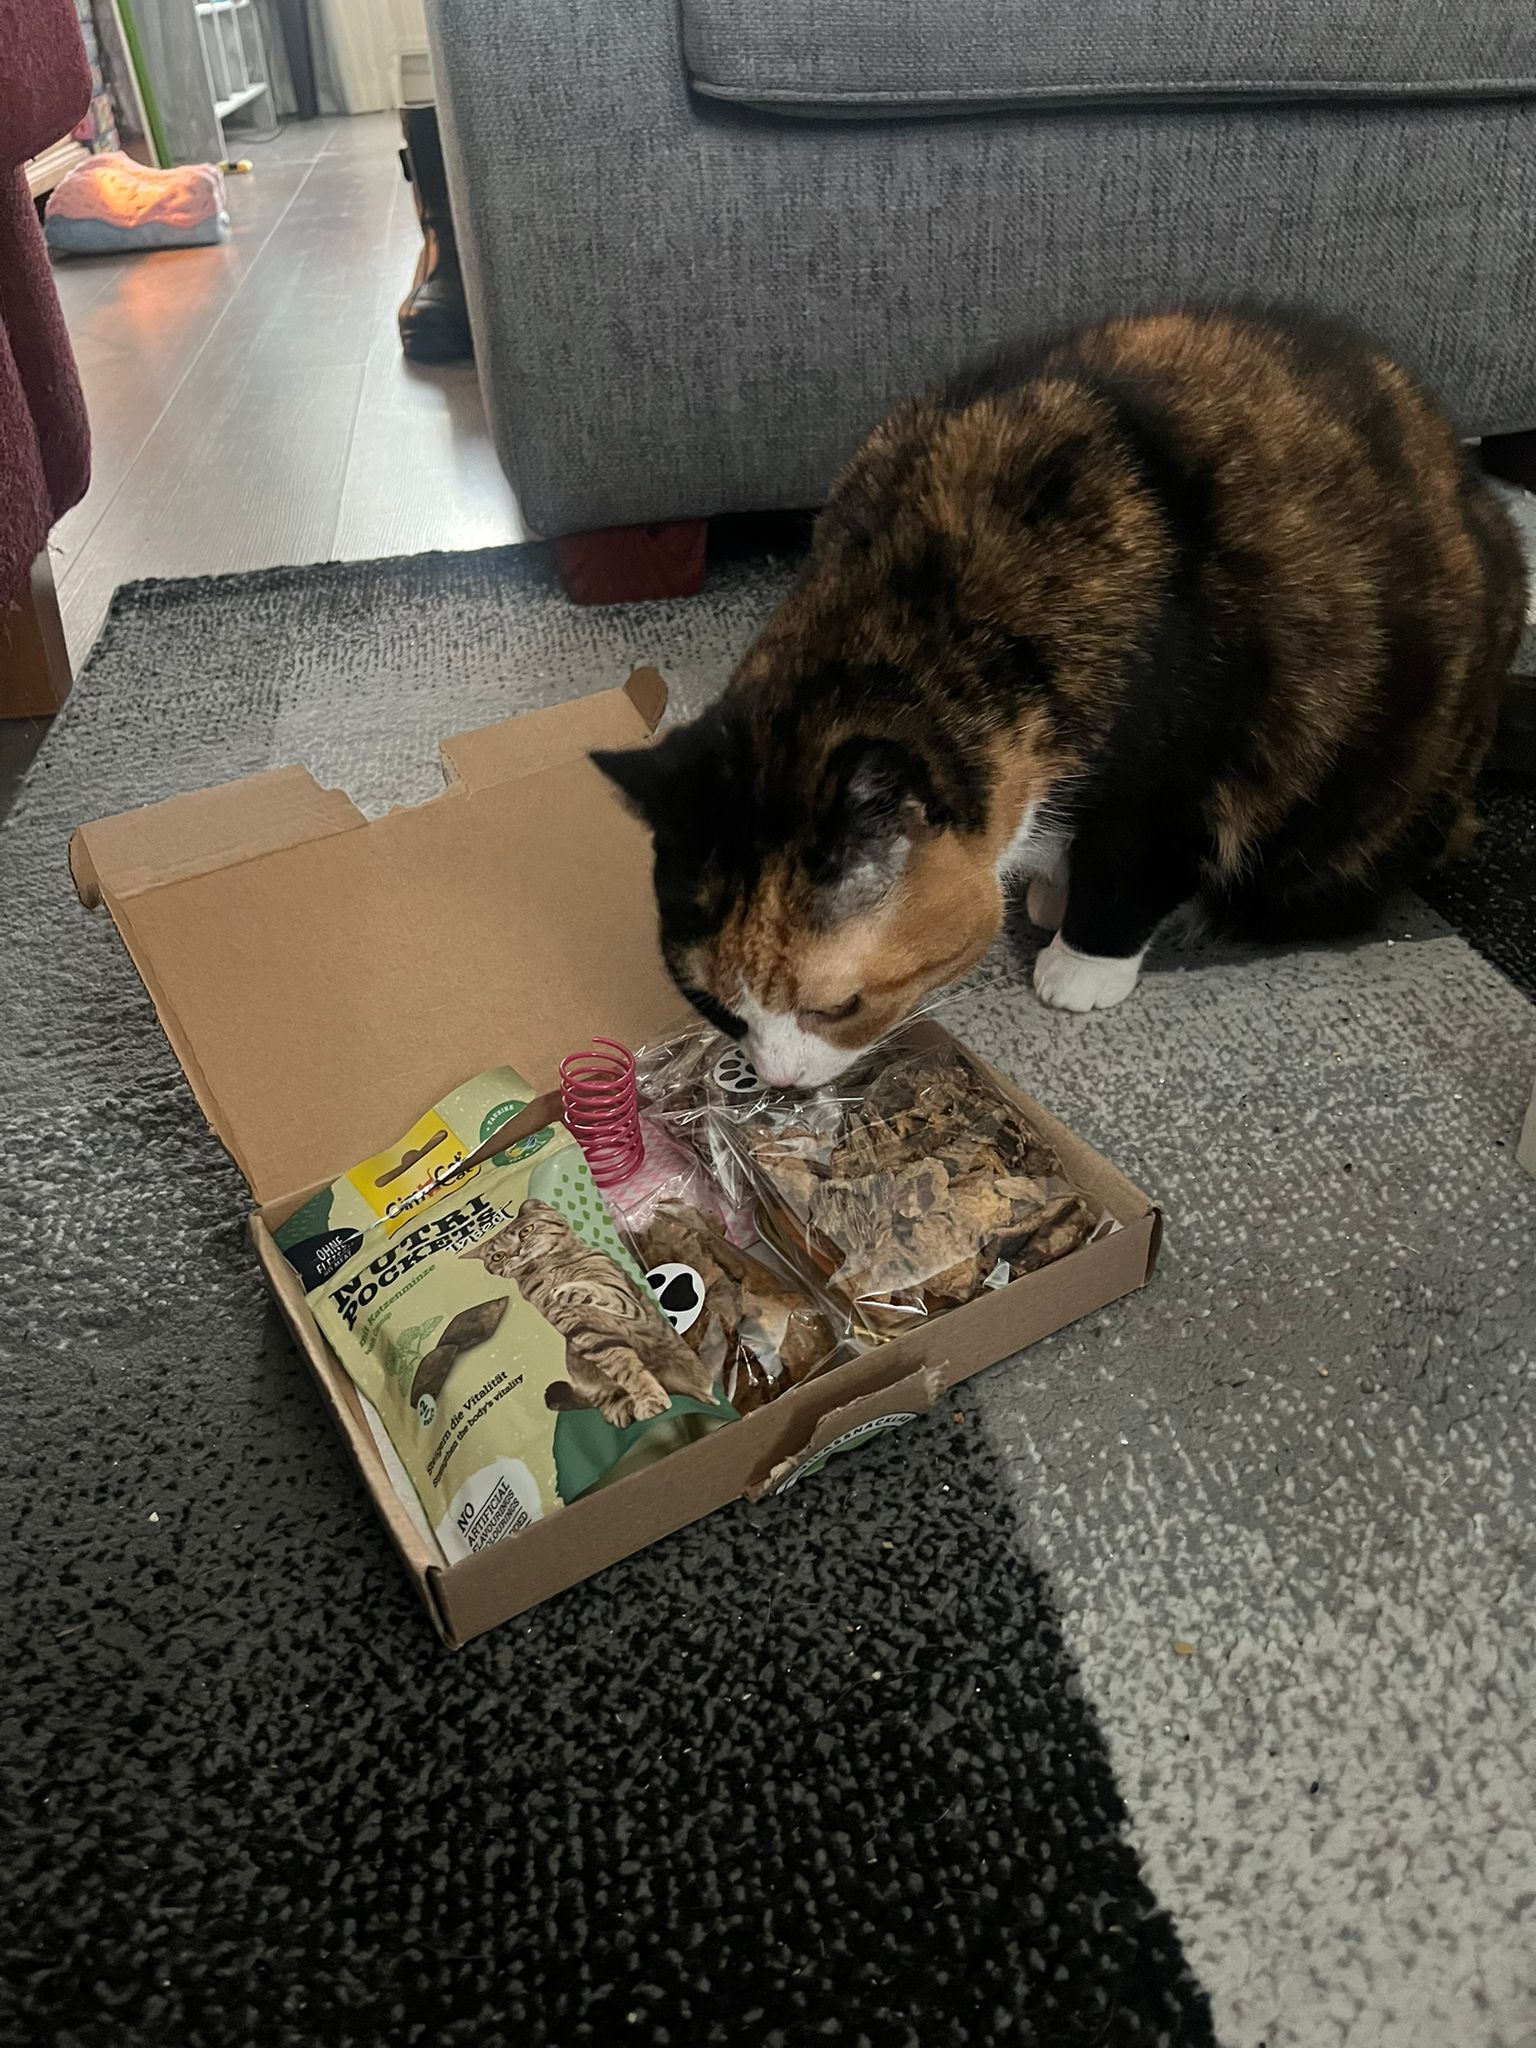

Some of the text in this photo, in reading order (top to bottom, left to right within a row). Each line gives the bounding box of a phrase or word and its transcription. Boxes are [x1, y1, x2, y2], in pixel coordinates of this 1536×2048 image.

[487, 1104, 514, 1125] TAURINE
[315, 1236, 346, 1261] OHNE
[328, 1193, 491, 1314] NUTRI
[342, 1207, 495, 1331] POCKETS
[367, 1264, 436, 1326] Katzenminze
[450, 1410, 465, 1430] die
[463, 1371, 508, 1411] Vitalität
[456, 1425, 469, 1441] the
[467, 1399, 494, 1427] body's
[493, 1374, 524, 1402] vitality
[457, 1502, 475, 1534] NO
[467, 1482, 510, 1547] ARTIFICIAL
[471, 1489, 515, 1553] FLAVOURINGS
